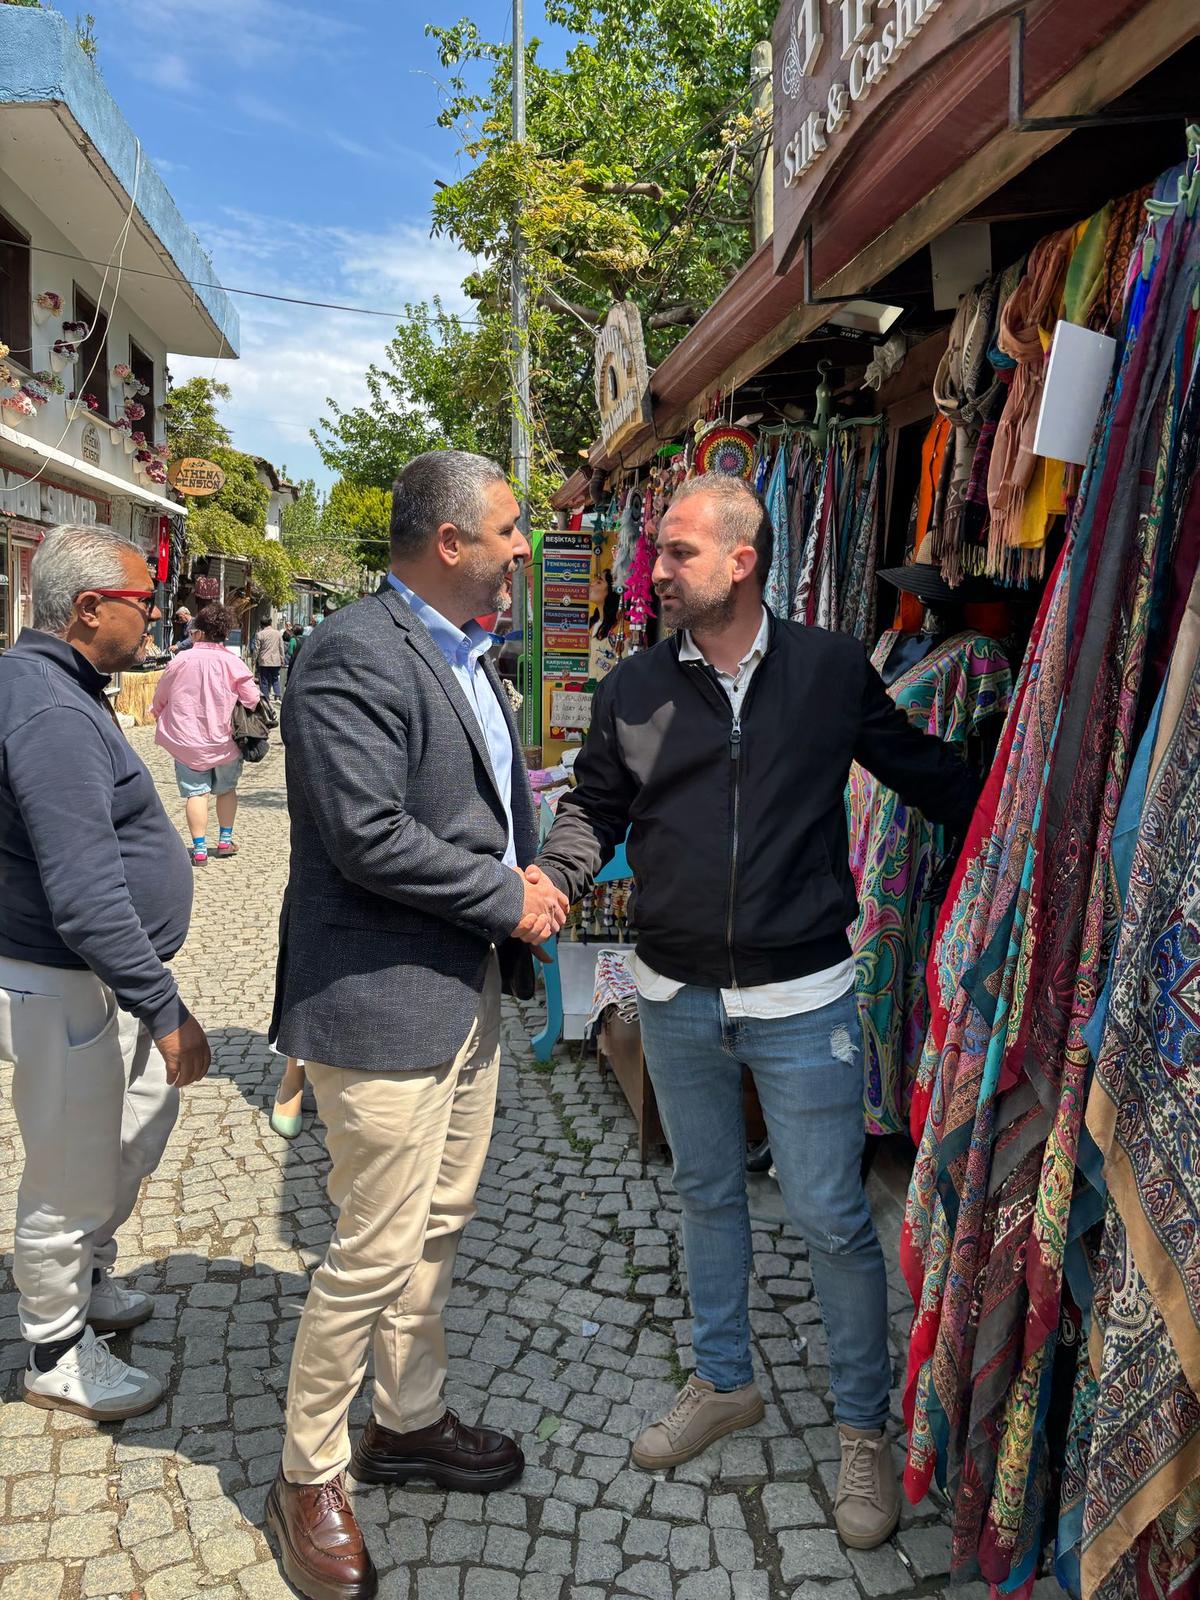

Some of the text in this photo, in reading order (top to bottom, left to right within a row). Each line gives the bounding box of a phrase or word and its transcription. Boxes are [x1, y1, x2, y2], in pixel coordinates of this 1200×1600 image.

[783, 111, 828, 189] Silk
[826, 83, 851, 134] &
[175, 468, 221, 481] ATHENA
[174, 477, 221, 490] PENSION
[545, 536, 576, 544] BEŞİKTAŞ
